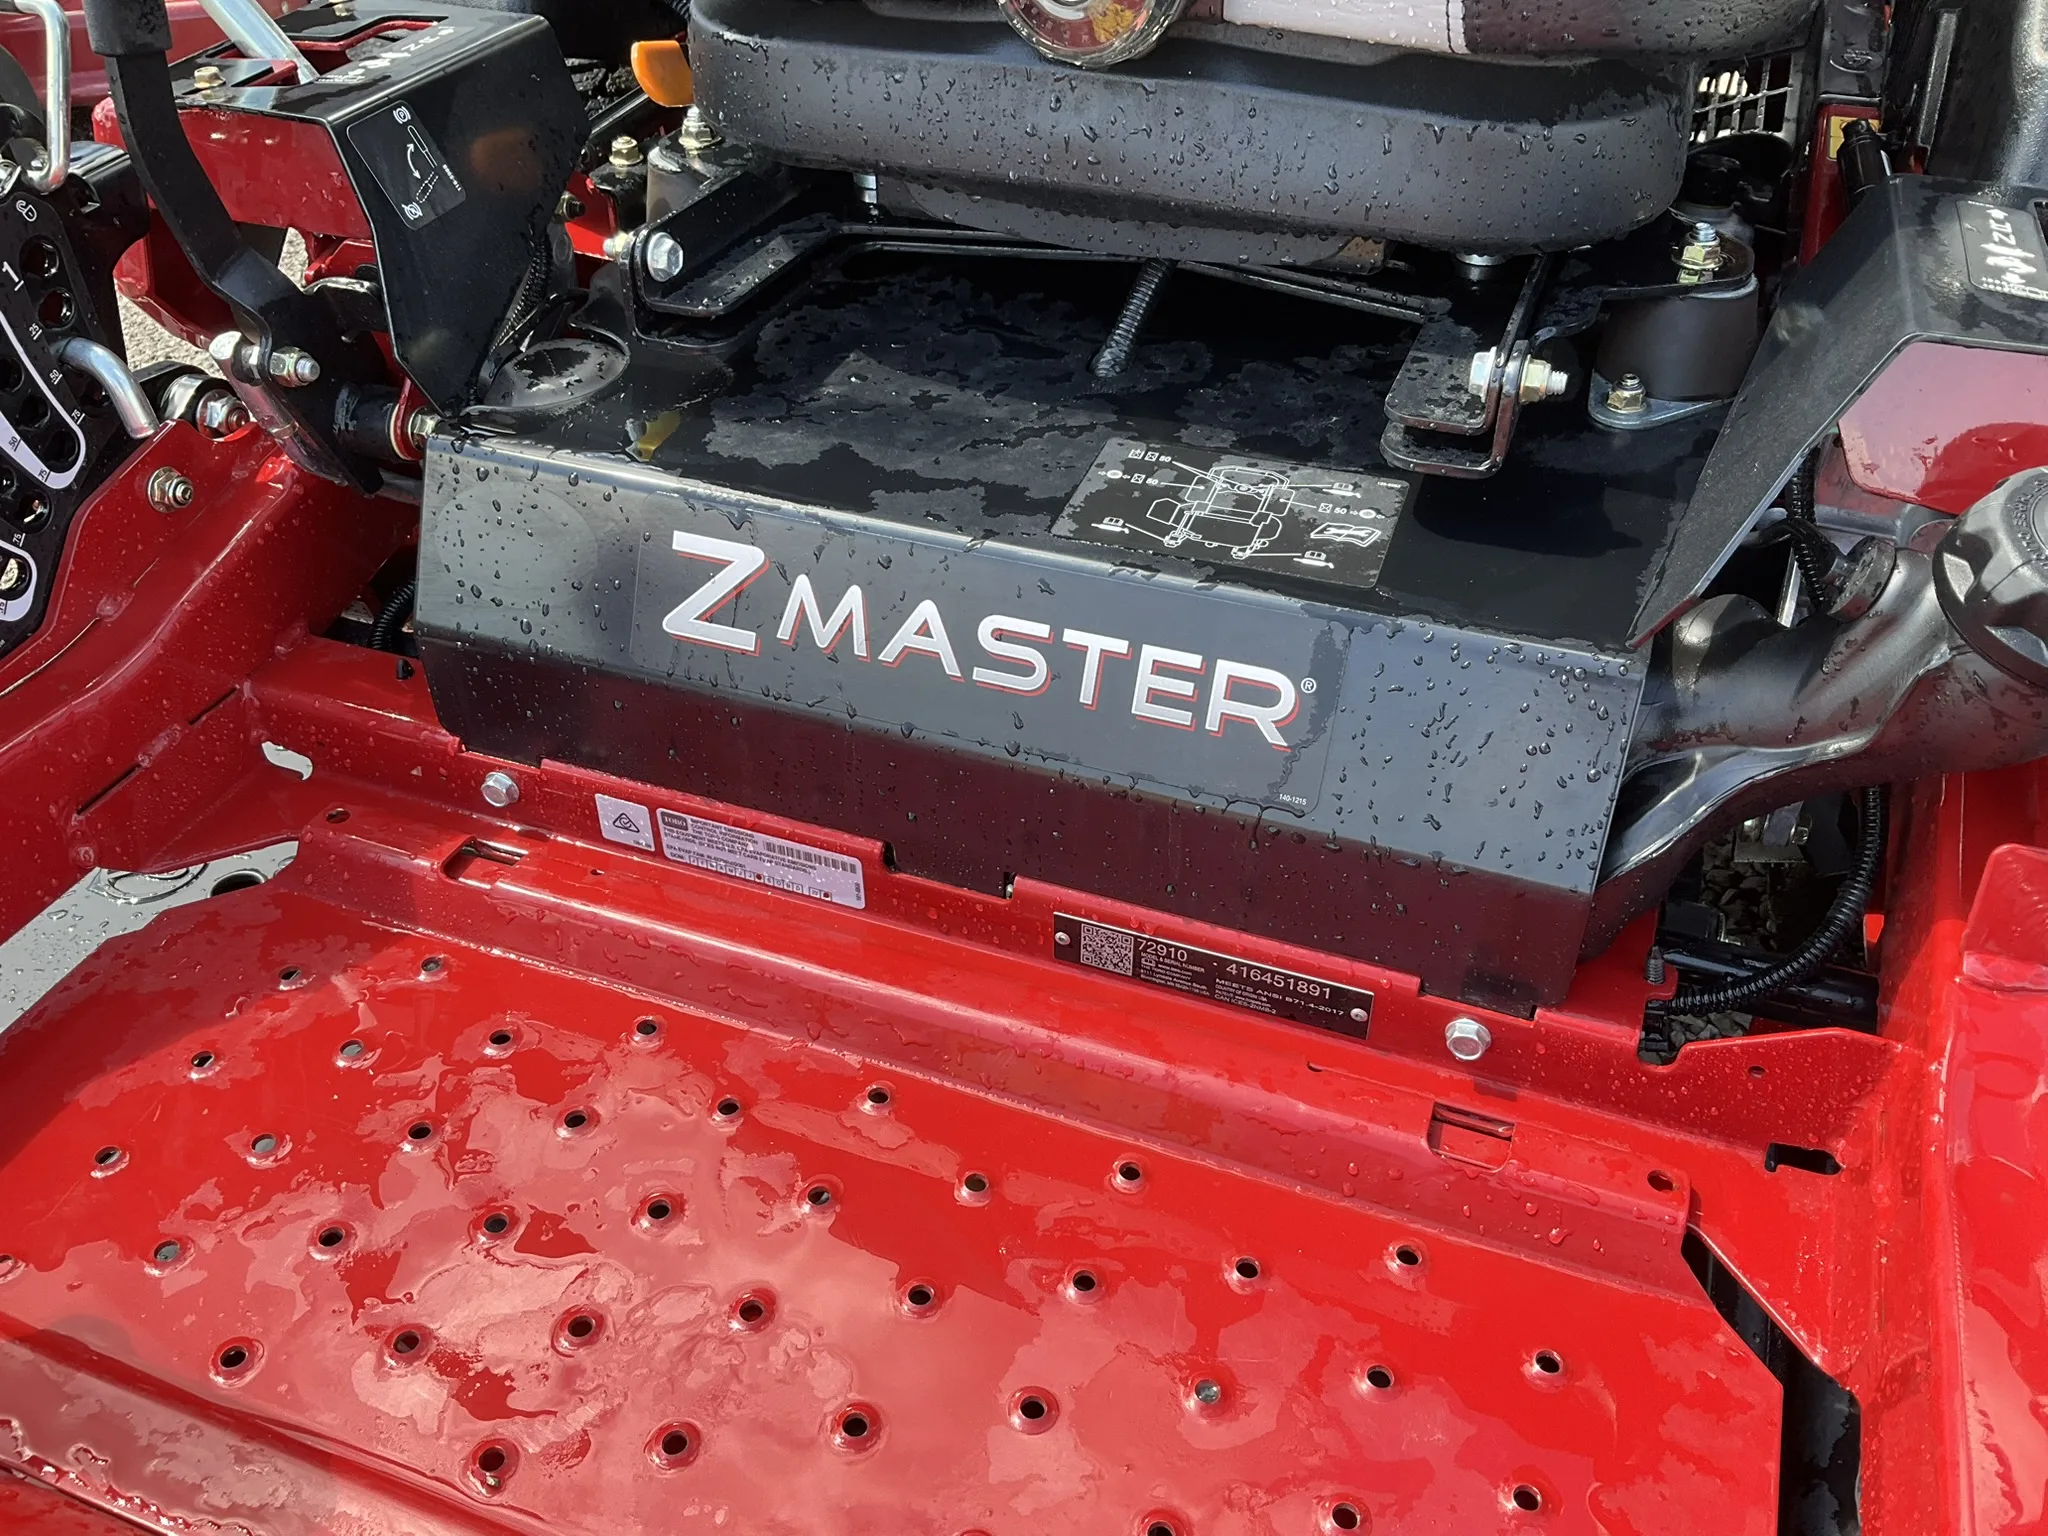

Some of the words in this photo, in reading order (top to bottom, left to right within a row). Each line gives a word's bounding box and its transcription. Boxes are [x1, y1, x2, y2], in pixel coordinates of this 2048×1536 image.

[1279, 793, 1307, 806] 140-1215
[1137, 938, 1187, 962] 72910
[1140, 952, 1158, 960] MODEL
[1182, 962, 1204, 972] NUMBER
[1226, 962, 1330, 999] 416451891
[1214, 993, 1229, 1002] CAN
[1215, 978, 1253, 992] MEETS
[1255, 988, 1281, 1000] ANSI
[1285, 996, 1344, 1016] B71.4-2017
